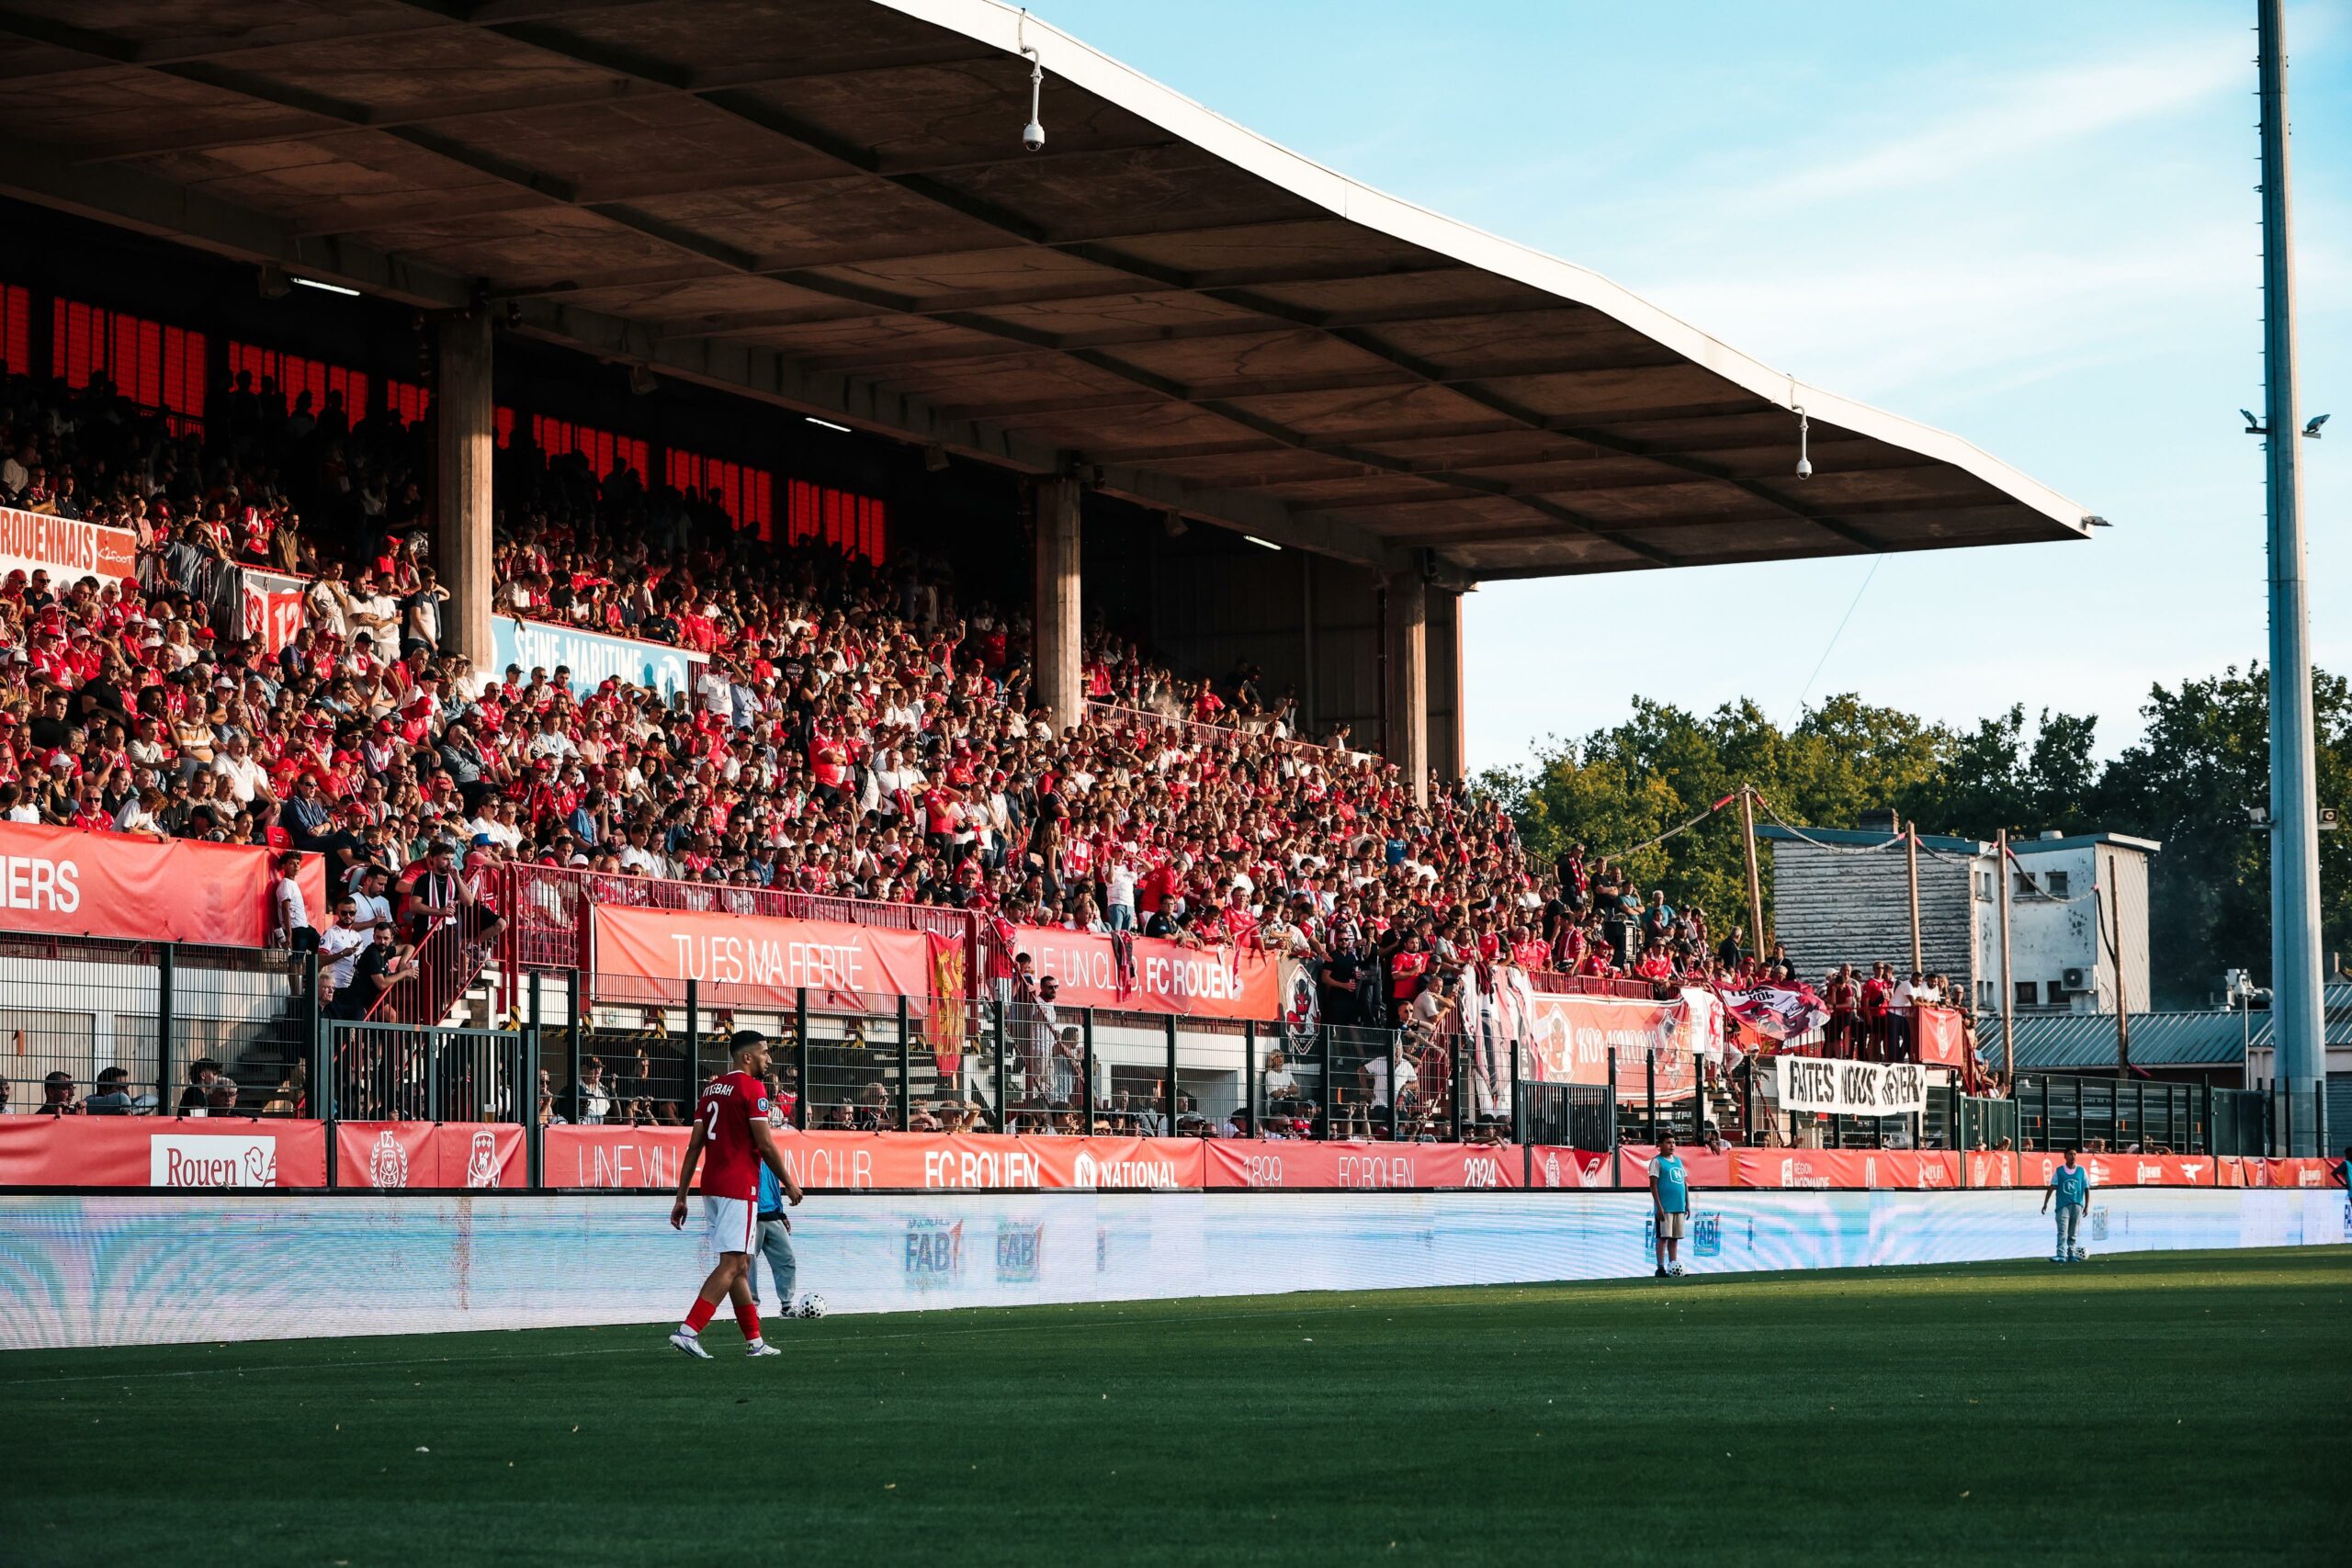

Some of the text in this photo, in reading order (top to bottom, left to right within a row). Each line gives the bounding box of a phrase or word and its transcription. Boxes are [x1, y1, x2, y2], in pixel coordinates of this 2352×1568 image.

[0, 509, 93, 570] ROUENNAIS
[672, 934, 864, 990] TU ES MA FIERTÉ
[1063, 948, 1090, 987] UN
[1146, 956, 1170, 995] FC
[1173, 959, 1234, 1000] ROUEN
[1790, 1060, 1835, 1103] FAITES
[1840, 1066, 1877, 1106] NOUS
[707, 1101, 718, 1140] 2
[166, 1147, 237, 1187] Rouen
[925, 1150, 1039, 1187] FC ROUEN
[1100, 1160, 1179, 1187] NATIONAL
[1242, 1156, 1283, 1187] 1899
[1338, 1156, 1359, 1187] FC
[1464, 1157, 1497, 1187] 2024
